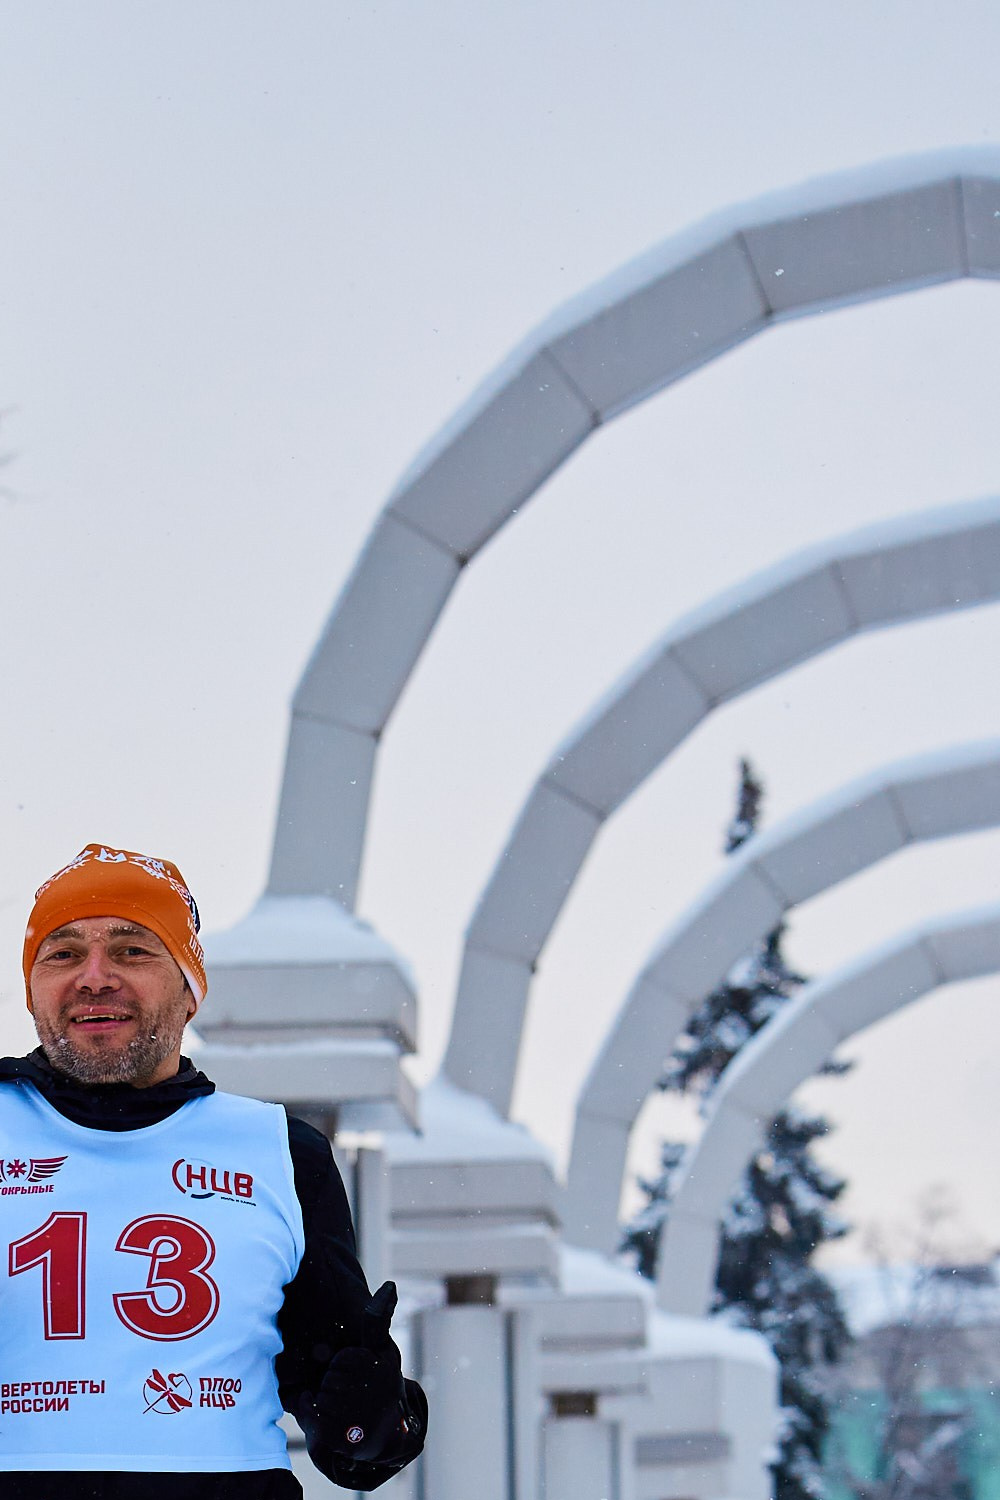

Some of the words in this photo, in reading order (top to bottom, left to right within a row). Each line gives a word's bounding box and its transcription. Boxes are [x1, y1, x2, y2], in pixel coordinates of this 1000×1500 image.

[186, 1163, 254, 1199] НЦВ
[8, 1211, 220, 1342] 13
[1, 1379, 105, 1398] ВЕРТОЛЕТЫ
[1, 1398, 69, 1414] РОССИИ
[199, 1393, 236, 1410] НЦВ
